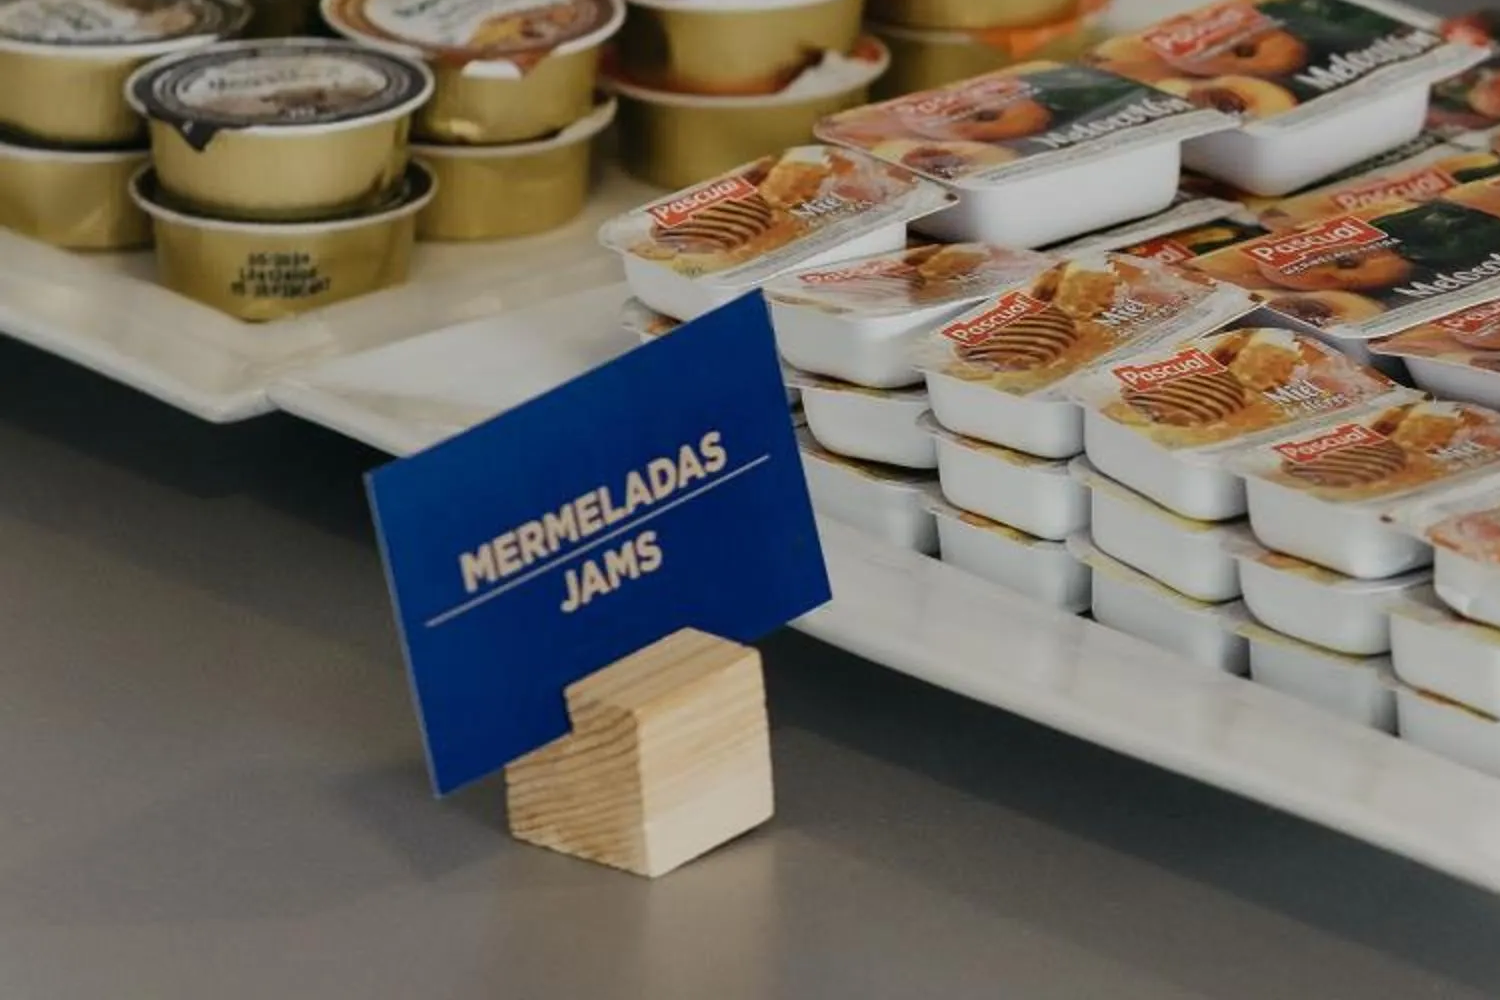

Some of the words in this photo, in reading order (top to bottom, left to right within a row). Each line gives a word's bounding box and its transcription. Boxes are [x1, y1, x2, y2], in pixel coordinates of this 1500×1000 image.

[1252, 221, 1364, 261] Pascual
[952, 295, 1032, 342] Pascual
[1122, 353, 1211, 387] Pascual
[459, 431, 728, 593] MERMELADAS
[560, 531, 663, 613] JAMS
